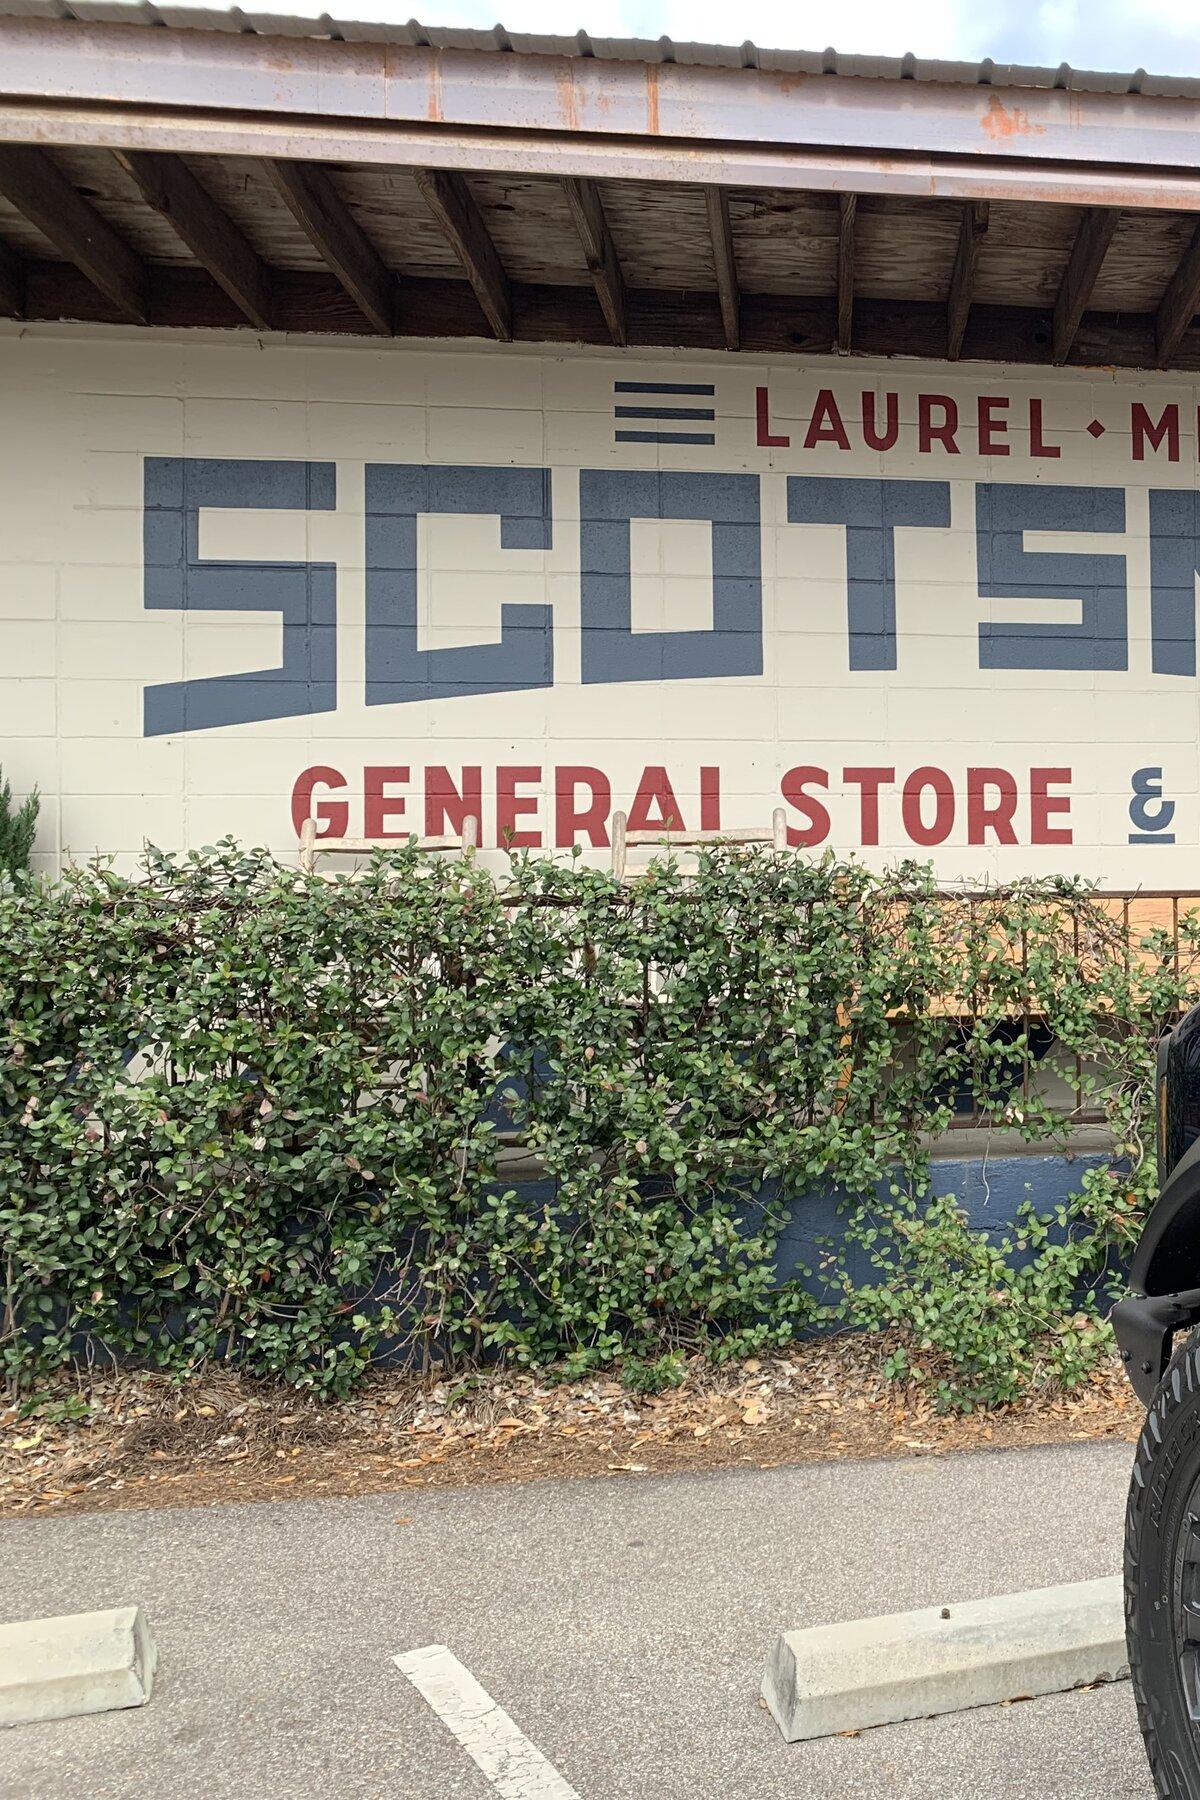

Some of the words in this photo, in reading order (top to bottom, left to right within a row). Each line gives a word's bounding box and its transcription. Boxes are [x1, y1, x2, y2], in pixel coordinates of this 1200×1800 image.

[757, 389, 1060, 458] LAUREL
[291, 765, 745, 849] GENERAL
[780, 765, 1074, 849] STORE
[1129, 766, 1175, 845] &
